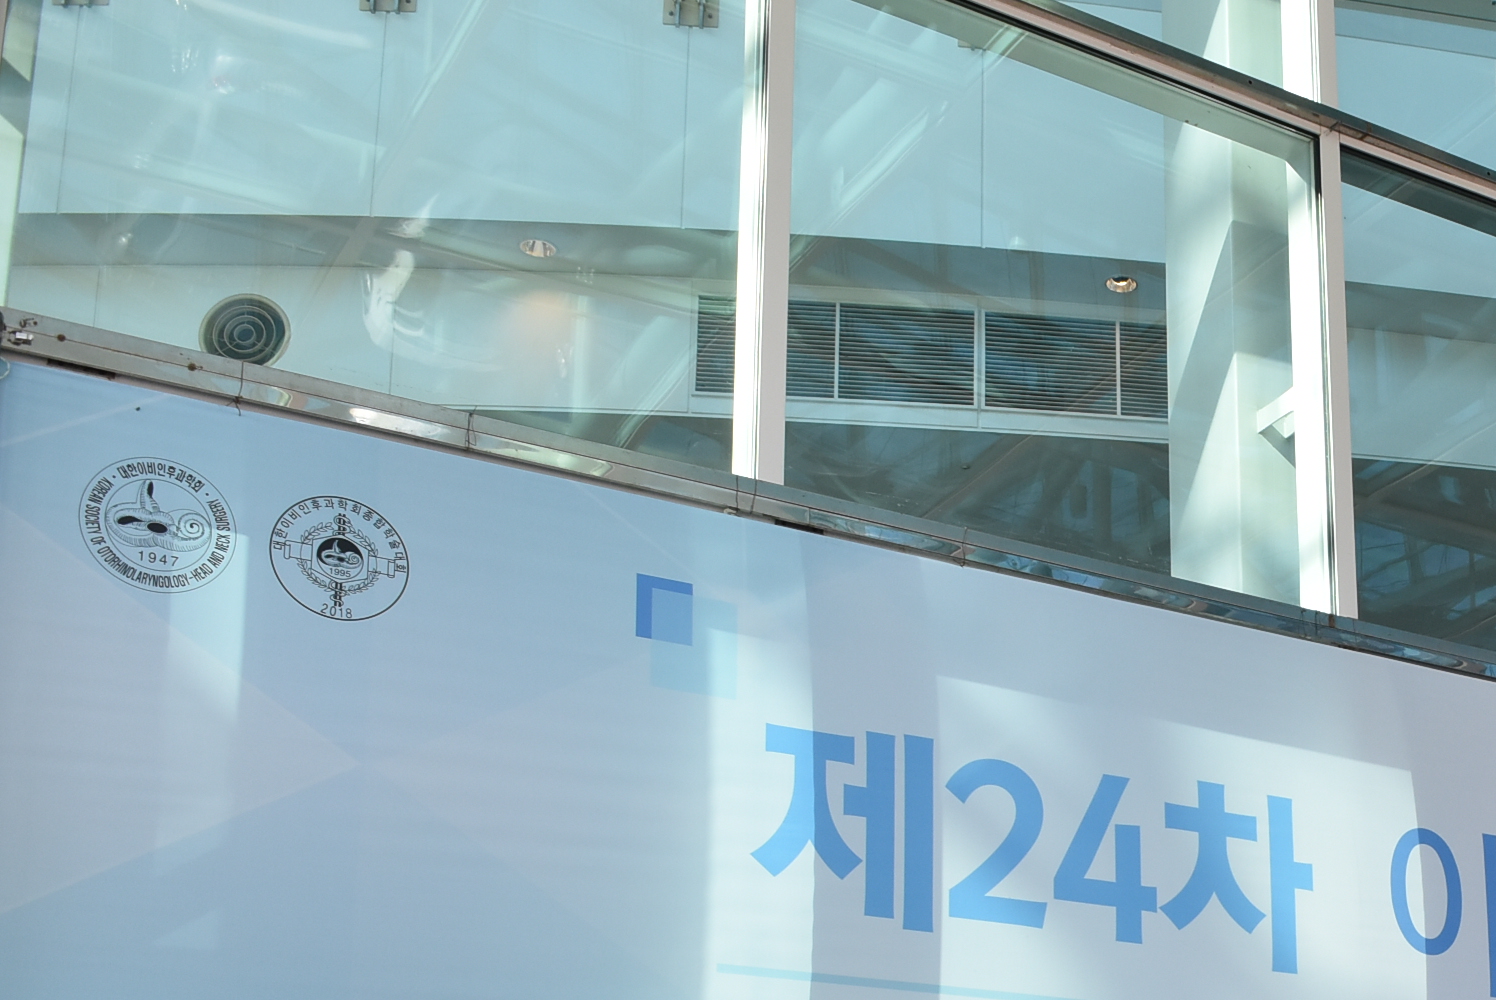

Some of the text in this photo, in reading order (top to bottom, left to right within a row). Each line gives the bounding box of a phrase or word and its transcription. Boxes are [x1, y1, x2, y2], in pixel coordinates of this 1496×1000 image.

[116, 461, 206, 494] 대한이비인후과학회
[87, 476, 115, 506] KOREAN
[84, 504, 101, 534] SOCIETY
[206, 498, 231, 533] SURGERY
[90, 535, 106, 546] OF
[218, 533, 231, 553] NECK
[138, 550, 180, 567] 1947
[206, 551, 226, 568] AND
[329, 567, 352, 578] 1995
[320, 602, 353, 619] 2018
[749, 722, 1315, 976] 제24차
